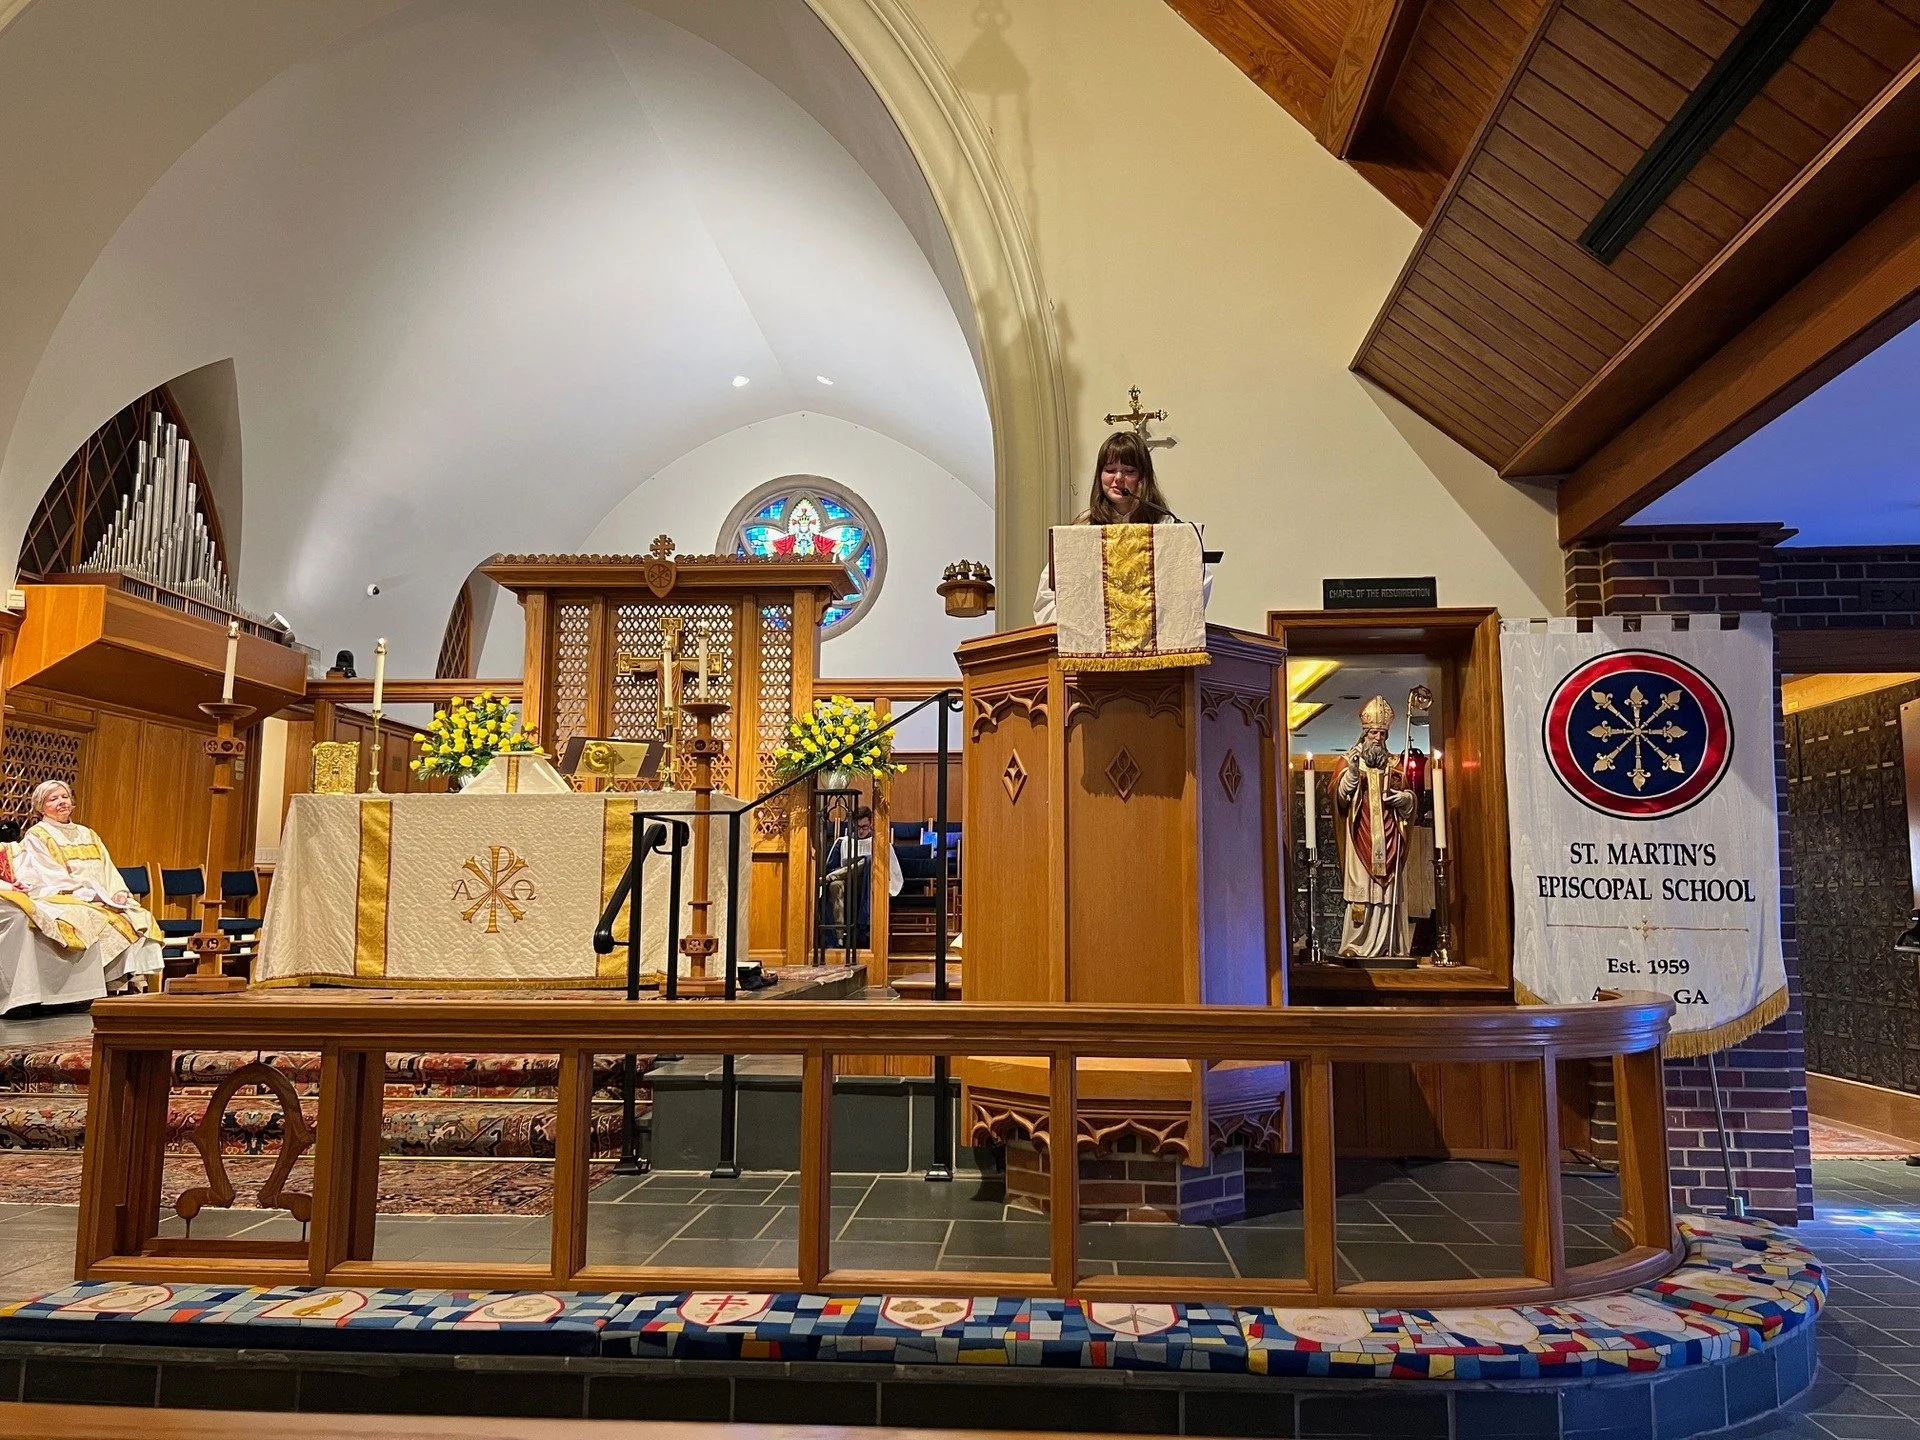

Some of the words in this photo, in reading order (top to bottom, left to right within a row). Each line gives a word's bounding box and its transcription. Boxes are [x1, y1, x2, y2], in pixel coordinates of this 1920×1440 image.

[1329, 589, 1354, 598] CHAPEL
[1356, 588, 1365, 598] OF
[1366, 588, 1379, 598] THE
[1871, 589, 1916, 603] EXI
[1570, 842, 1598, 865] ST.
[1607, 842, 1716, 866] MARTIN'S
[1537, 875, 1652, 900] EPISCOPAL
[1662, 878, 1756, 902] SCHOOL
[1606, 958, 1641, 974] Est.
[1647, 959, 1690, 975] 1959
[1673, 989, 1709, 1005] GA
